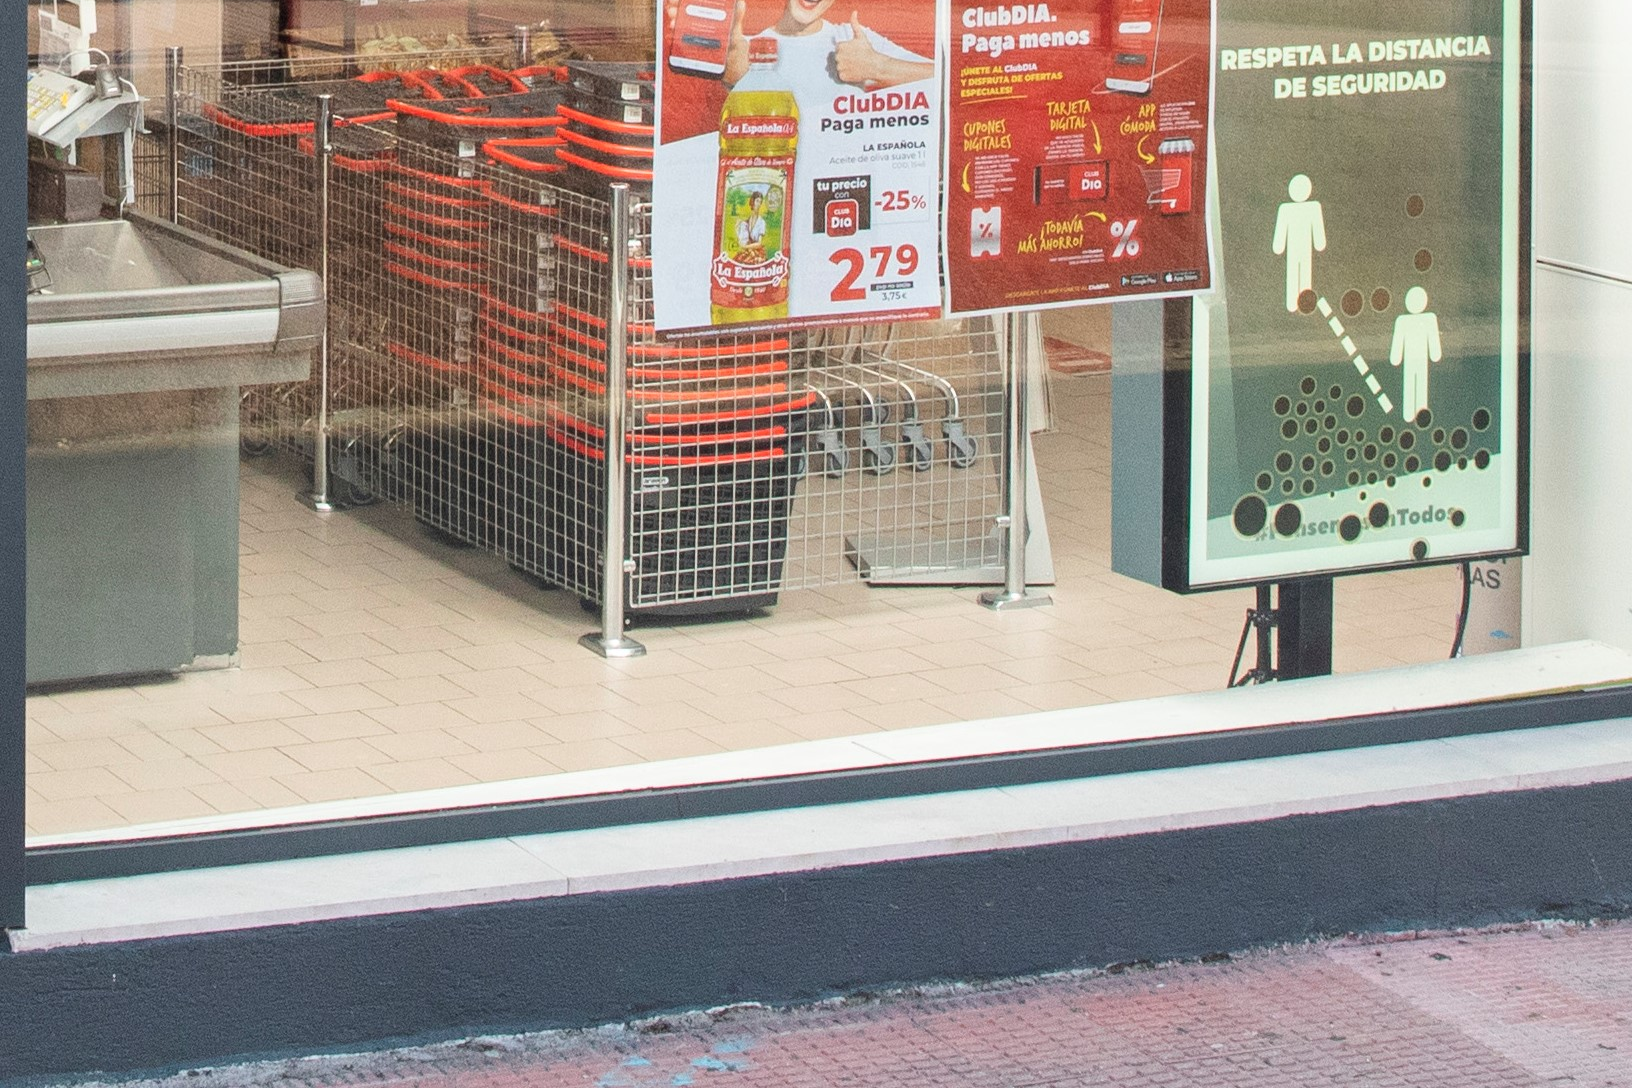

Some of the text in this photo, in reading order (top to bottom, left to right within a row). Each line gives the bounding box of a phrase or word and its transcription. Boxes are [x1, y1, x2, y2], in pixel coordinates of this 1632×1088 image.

[962, 3, 1057, 28] ClubDIA.
[961, 29, 1090, 58] Paga menos
[1221, 35, 1491, 71] RESPETA LA DISTANCIA
[992, 65, 1003, 74] AL
[960, 71, 1063, 87] Y DISFRUTA DE OFERTAS
[1274, 69, 1446, 99] DE SEGURIDAD
[961, 86, 1013, 97] ESPECIALES!
[833, 92, 930, 114] ClubDIA
[1046, 99, 1091, 116] TARJETA
[1139, 103, 1156, 118] APP
[821, 114, 930, 133] Paga menos
[963, 118, 1005, 137] CUPONES
[1050, 115, 1087, 131] DIGITAL
[1120, 115, 1156, 136] CÓMODA
[863, 140, 926, 152] LA ESPAÑOLA
[963, 133, 1011, 152] DIGITALES
[829, 156, 856, 165] Aceite
[857, 155, 869, 163] de
[870, 153, 889, 163] oliva
[891, 152, 916, 161] suave
[817, 178, 867, 192] tu precio
[1018, 234, 1083, 254] MÁS AHORRO!
[718, 263, 783, 281] La Española
